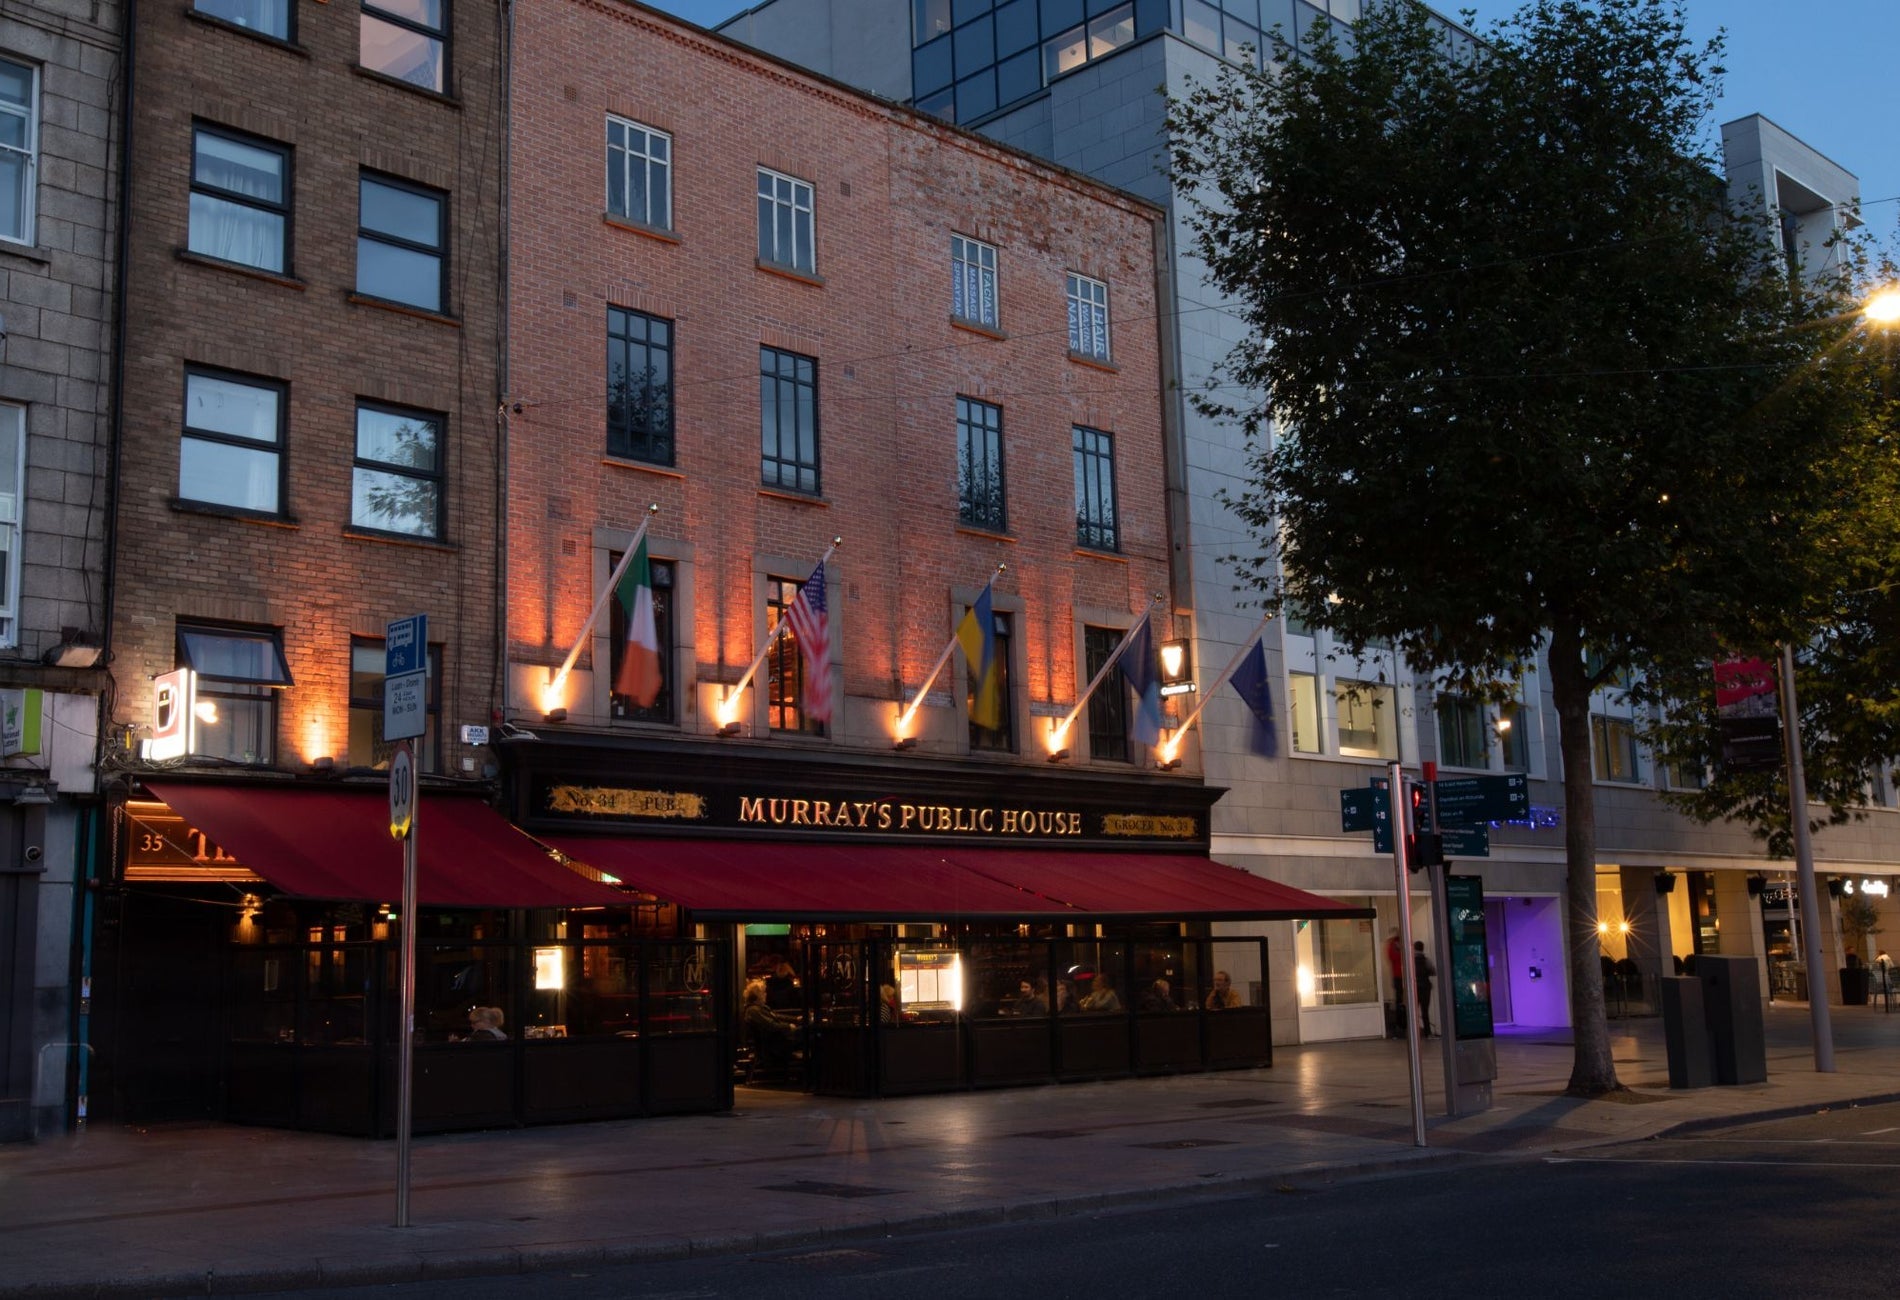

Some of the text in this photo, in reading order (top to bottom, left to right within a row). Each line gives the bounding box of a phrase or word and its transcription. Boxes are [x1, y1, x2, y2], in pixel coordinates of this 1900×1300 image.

[968, 267, 977, 320] MASSAGE
[983, 272, 993, 324] FACIALS
[1068, 301, 1079, 350] NAILS
[1082, 304, 1091, 353] WAXING
[1094, 312, 1105, 353] HAIR
[394, 765, 408, 808] 30
[566, 790, 676, 811] No. 34 PUB
[737, 796, 1082, 835] MURRAY'S PUBLIC HOUSE
[140, 833, 163, 852] 35
